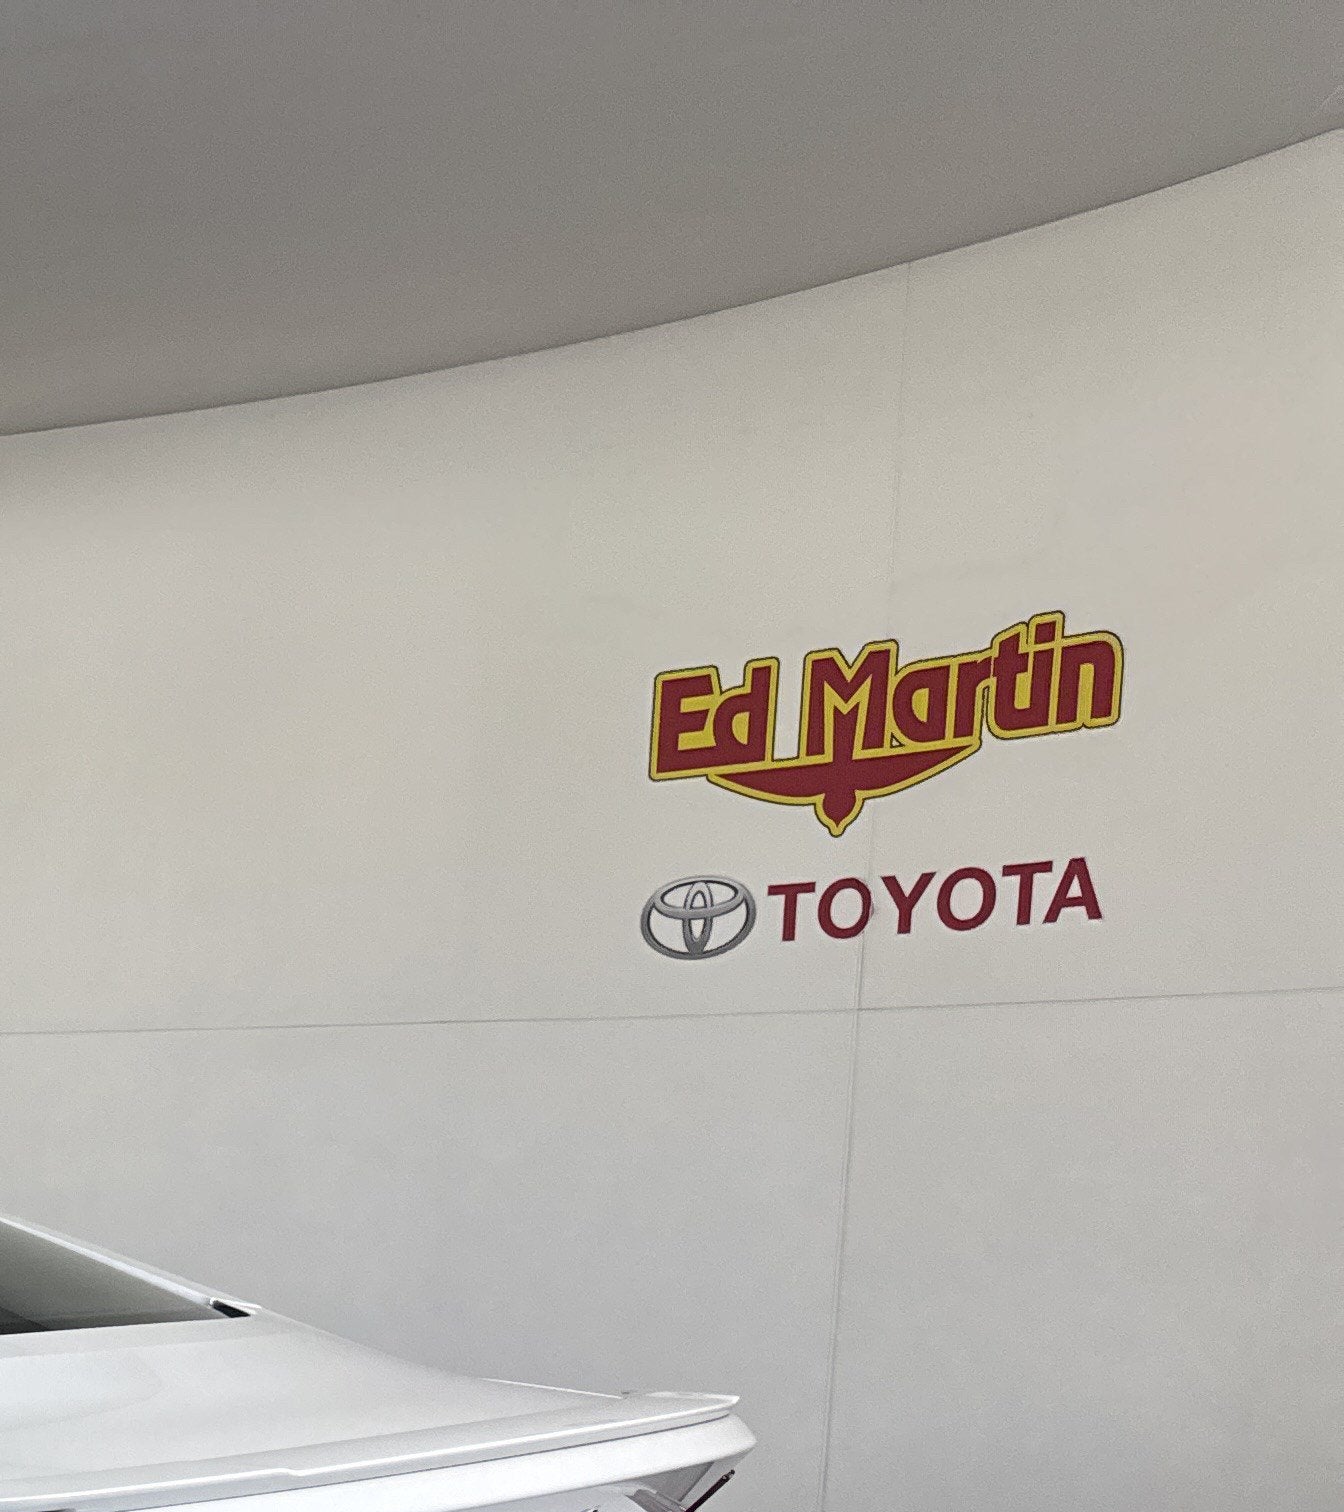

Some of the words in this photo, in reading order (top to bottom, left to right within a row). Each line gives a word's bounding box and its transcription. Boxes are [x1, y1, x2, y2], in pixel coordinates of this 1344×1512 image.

[649, 657, 779, 781] Ed
[798, 611, 1124, 762] Martin
[767, 857, 1103, 942] TOYOTA
